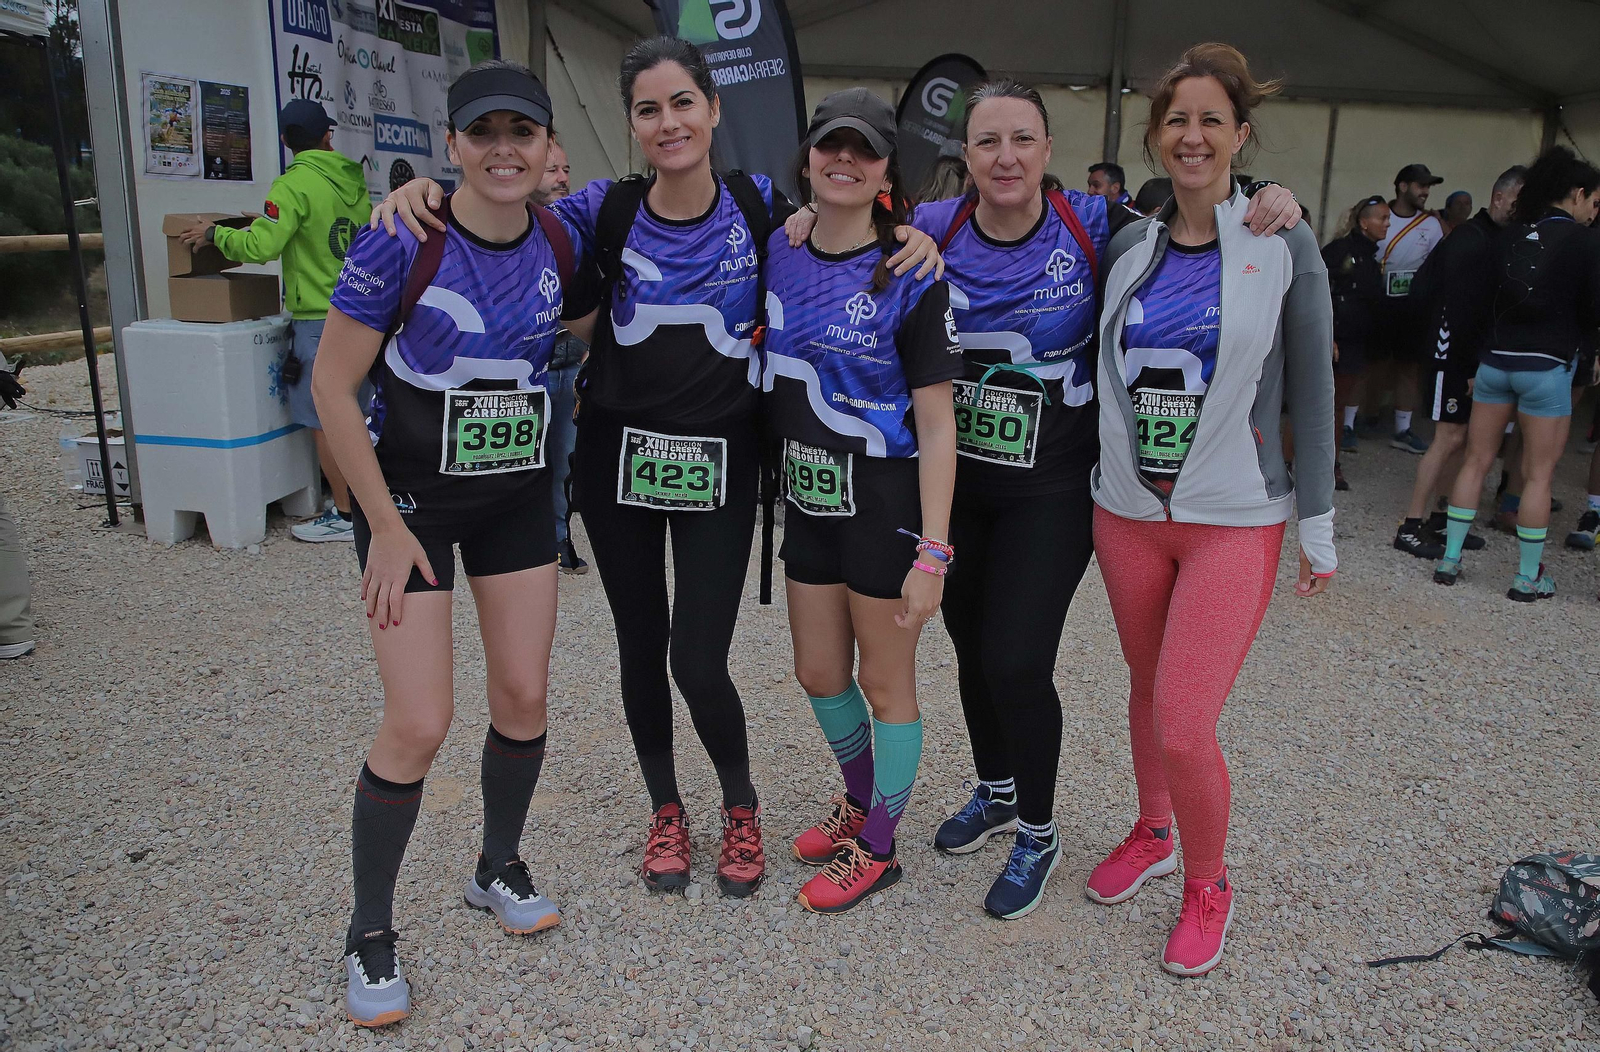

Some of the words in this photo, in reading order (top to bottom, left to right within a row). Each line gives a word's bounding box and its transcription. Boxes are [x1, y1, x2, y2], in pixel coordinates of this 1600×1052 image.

[370, 50, 396, 74] Clavel
[719, 248, 758, 273] mundi
[347, 276, 372, 296] Cádiz
[1033, 278, 1084, 301] mundi
[1392, 279, 1410, 289] 44
[535, 297, 564, 326] mund
[825, 323, 878, 350] mundi
[962, 385, 985, 400] XII
[985, 395, 1017, 405] CRESTA
[1139, 392, 1161, 407] XIII
[472, 395, 499, 409] XIII
[499, 399, 529, 409] CRESTA
[955, 395, 1024, 414] CABONERA
[463, 405, 534, 418] CARBONERA
[1133, 404, 1200, 417] CARBONER
[954, 407, 1023, 443] 350
[462, 419, 535, 451] 398
[1136, 418, 1197, 449] 424
[644, 436, 670, 452] XIII
[670, 440, 702, 448] EDICIÓN
[669, 446, 703, 454] CRESTA
[800, 446, 828, 456] CRESTA
[637, 447, 710, 462] CARBONERA
[635, 460, 710, 492] 423
[788, 459, 837, 495] 399
[86, 480, 105, 489] FRAG
